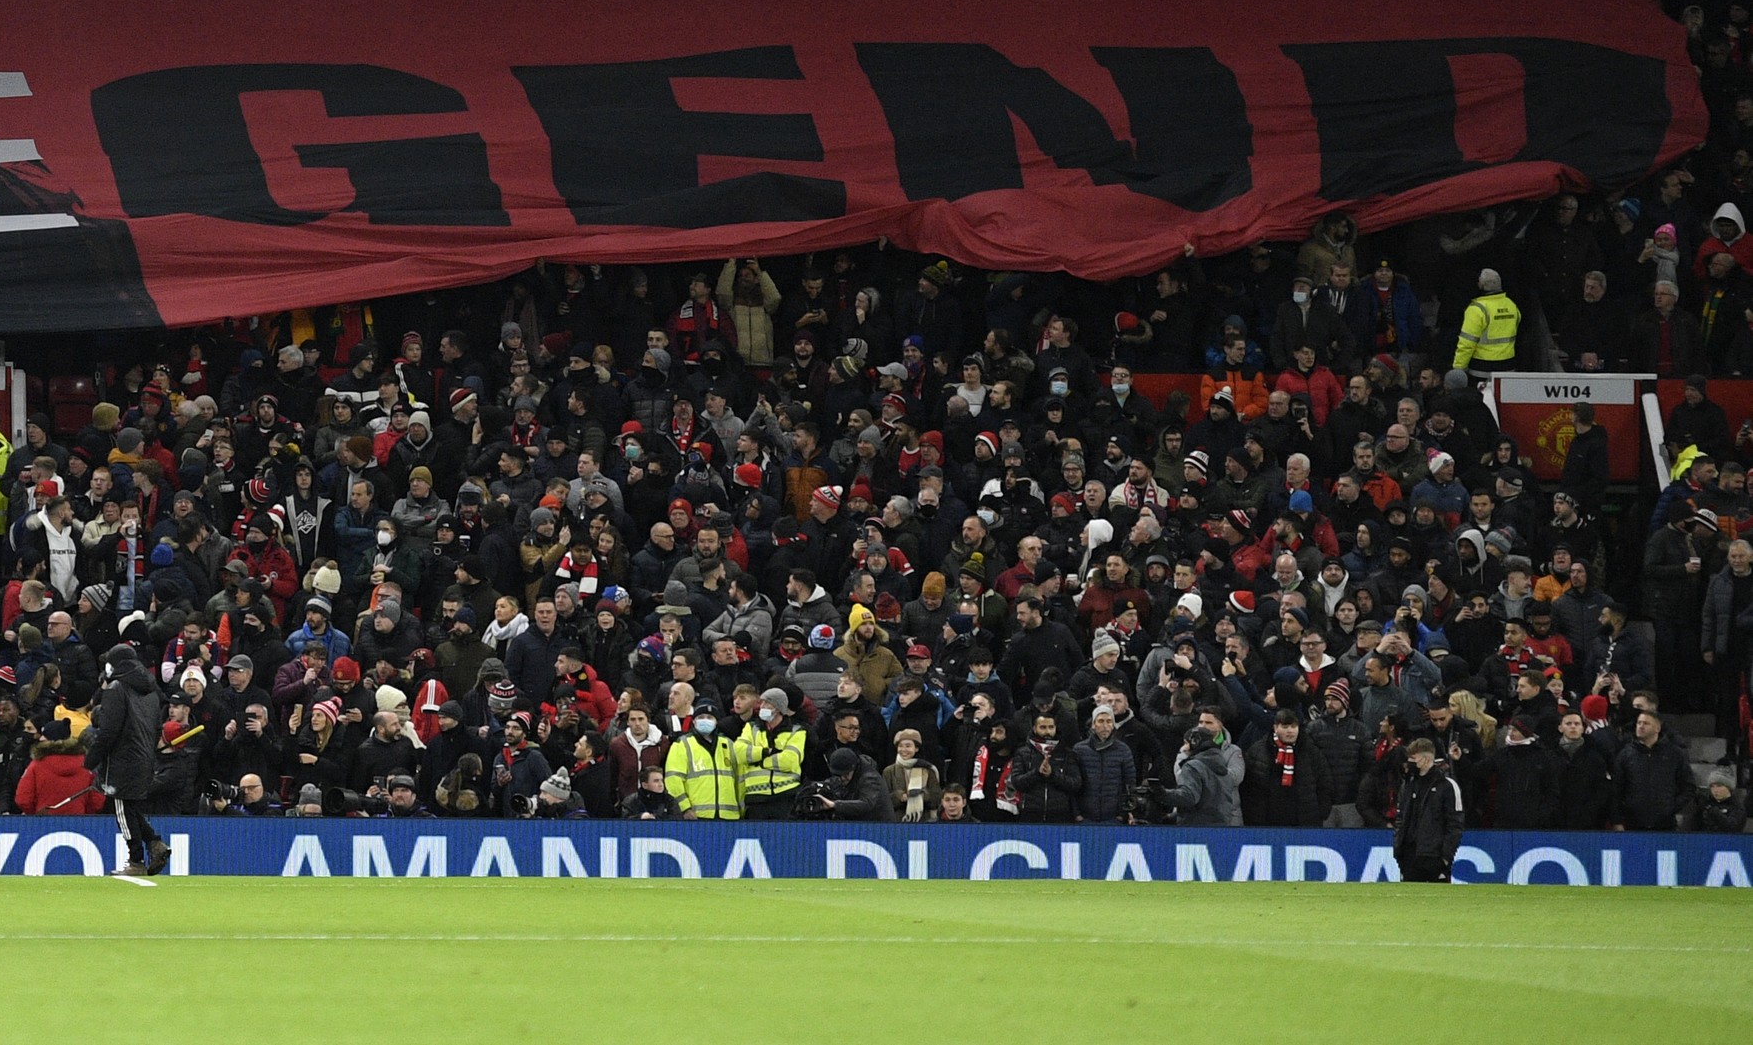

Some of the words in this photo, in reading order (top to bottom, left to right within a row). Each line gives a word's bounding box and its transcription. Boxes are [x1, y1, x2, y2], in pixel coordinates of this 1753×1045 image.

[1544, 385, 1591, 398] W104
[1542, 413, 1574, 433] MANCH
[281, 834, 773, 879] AMANDA
